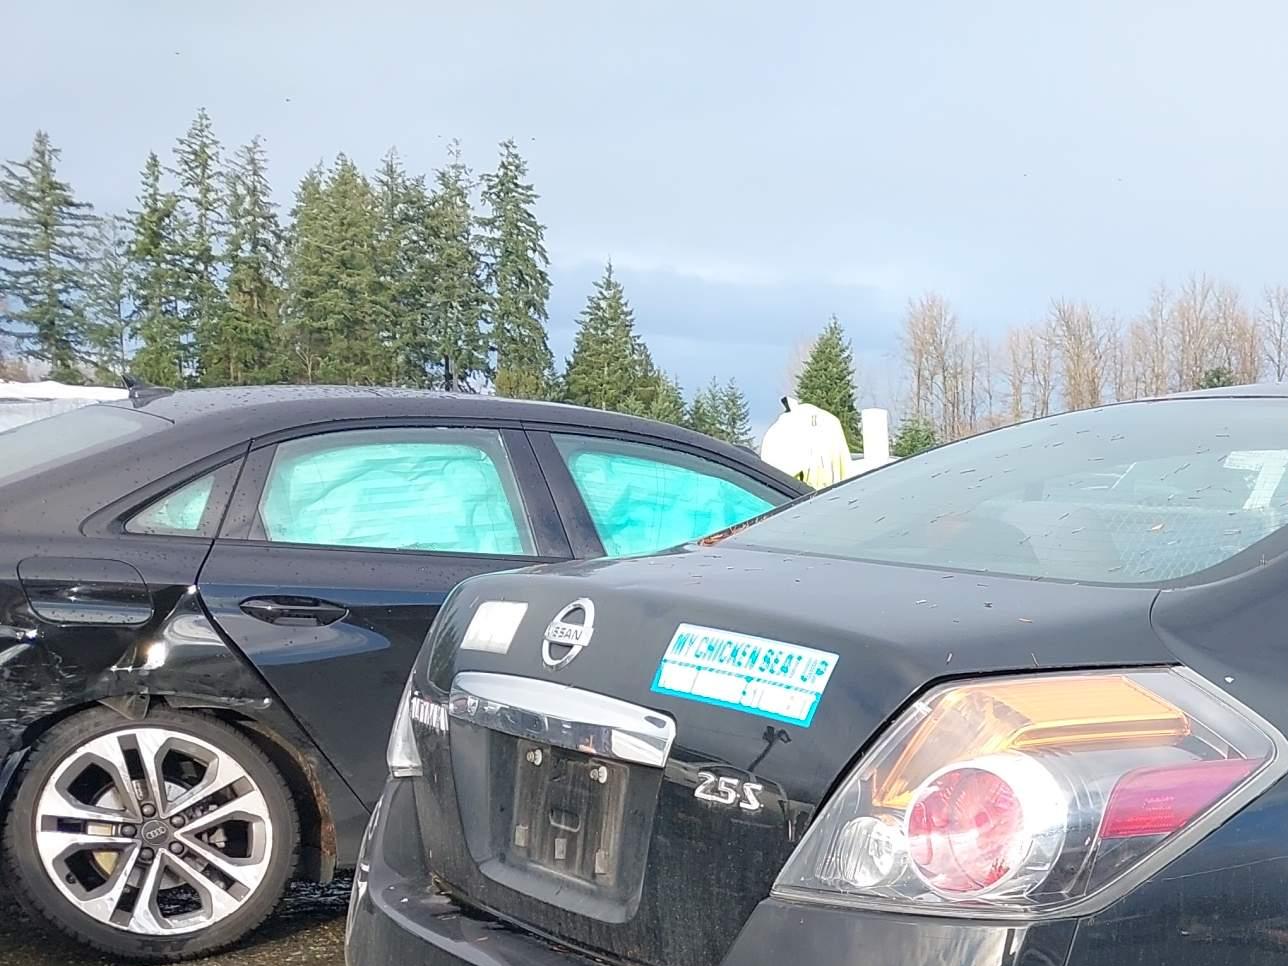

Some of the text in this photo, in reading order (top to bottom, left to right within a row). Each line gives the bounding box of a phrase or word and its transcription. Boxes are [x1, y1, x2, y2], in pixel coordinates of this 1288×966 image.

[671, 632, 697, 657] MY
[694, 635, 763, 670] CHICKEN
[799, 656, 829, 685] UP
